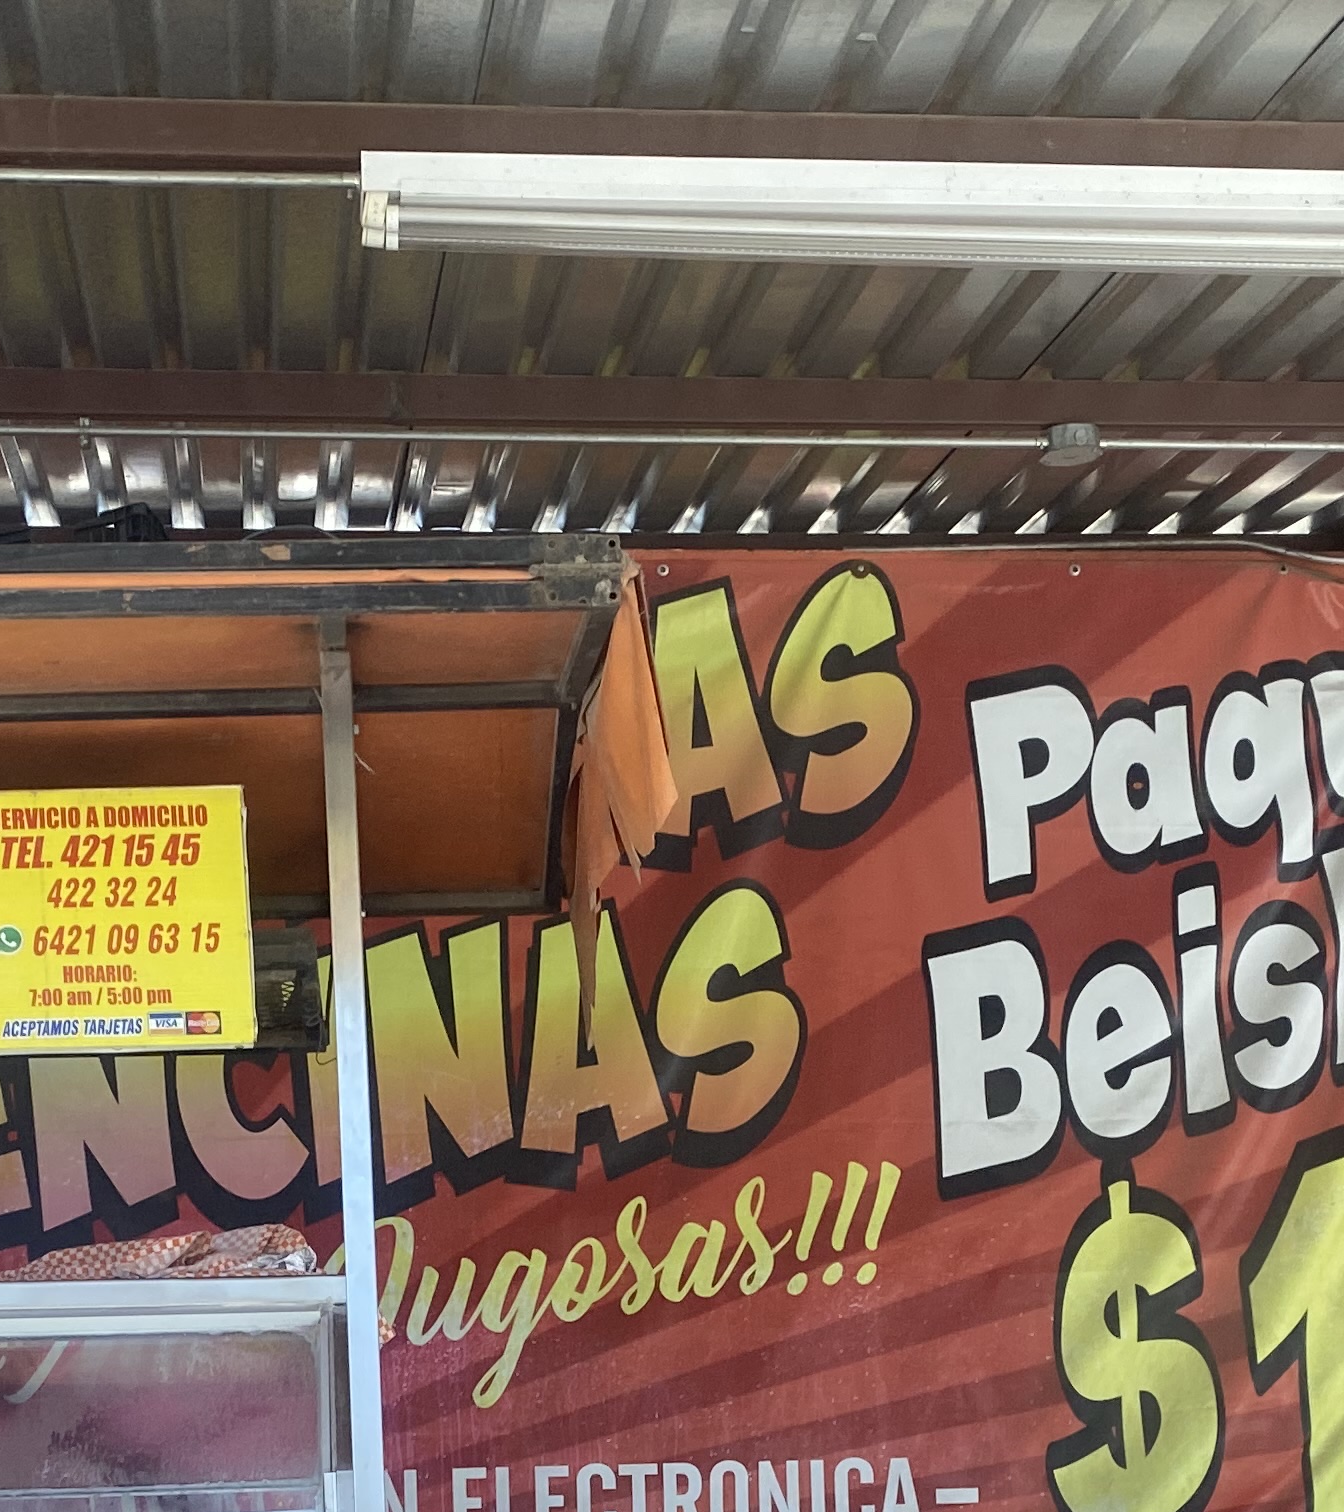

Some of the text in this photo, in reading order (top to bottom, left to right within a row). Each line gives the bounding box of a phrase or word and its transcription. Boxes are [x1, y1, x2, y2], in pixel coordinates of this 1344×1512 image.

[86, 807, 99, 828] A
[104, 805, 208, 827] DOMICILIO
[1, 833, 201, 869] TEL. 421 15 45
[47, 877, 177, 908] 422 32 24
[33, 922, 221, 956] 6421 09 63 15
[63, 965, 137, 983] HORARIO:
[29, 987, 172, 1006] 7:00 am 5:00 pm
[3, 1018, 142, 1038] ACEPTAMOS TARJETAS
[155, 1018, 177, 1028] VISA
